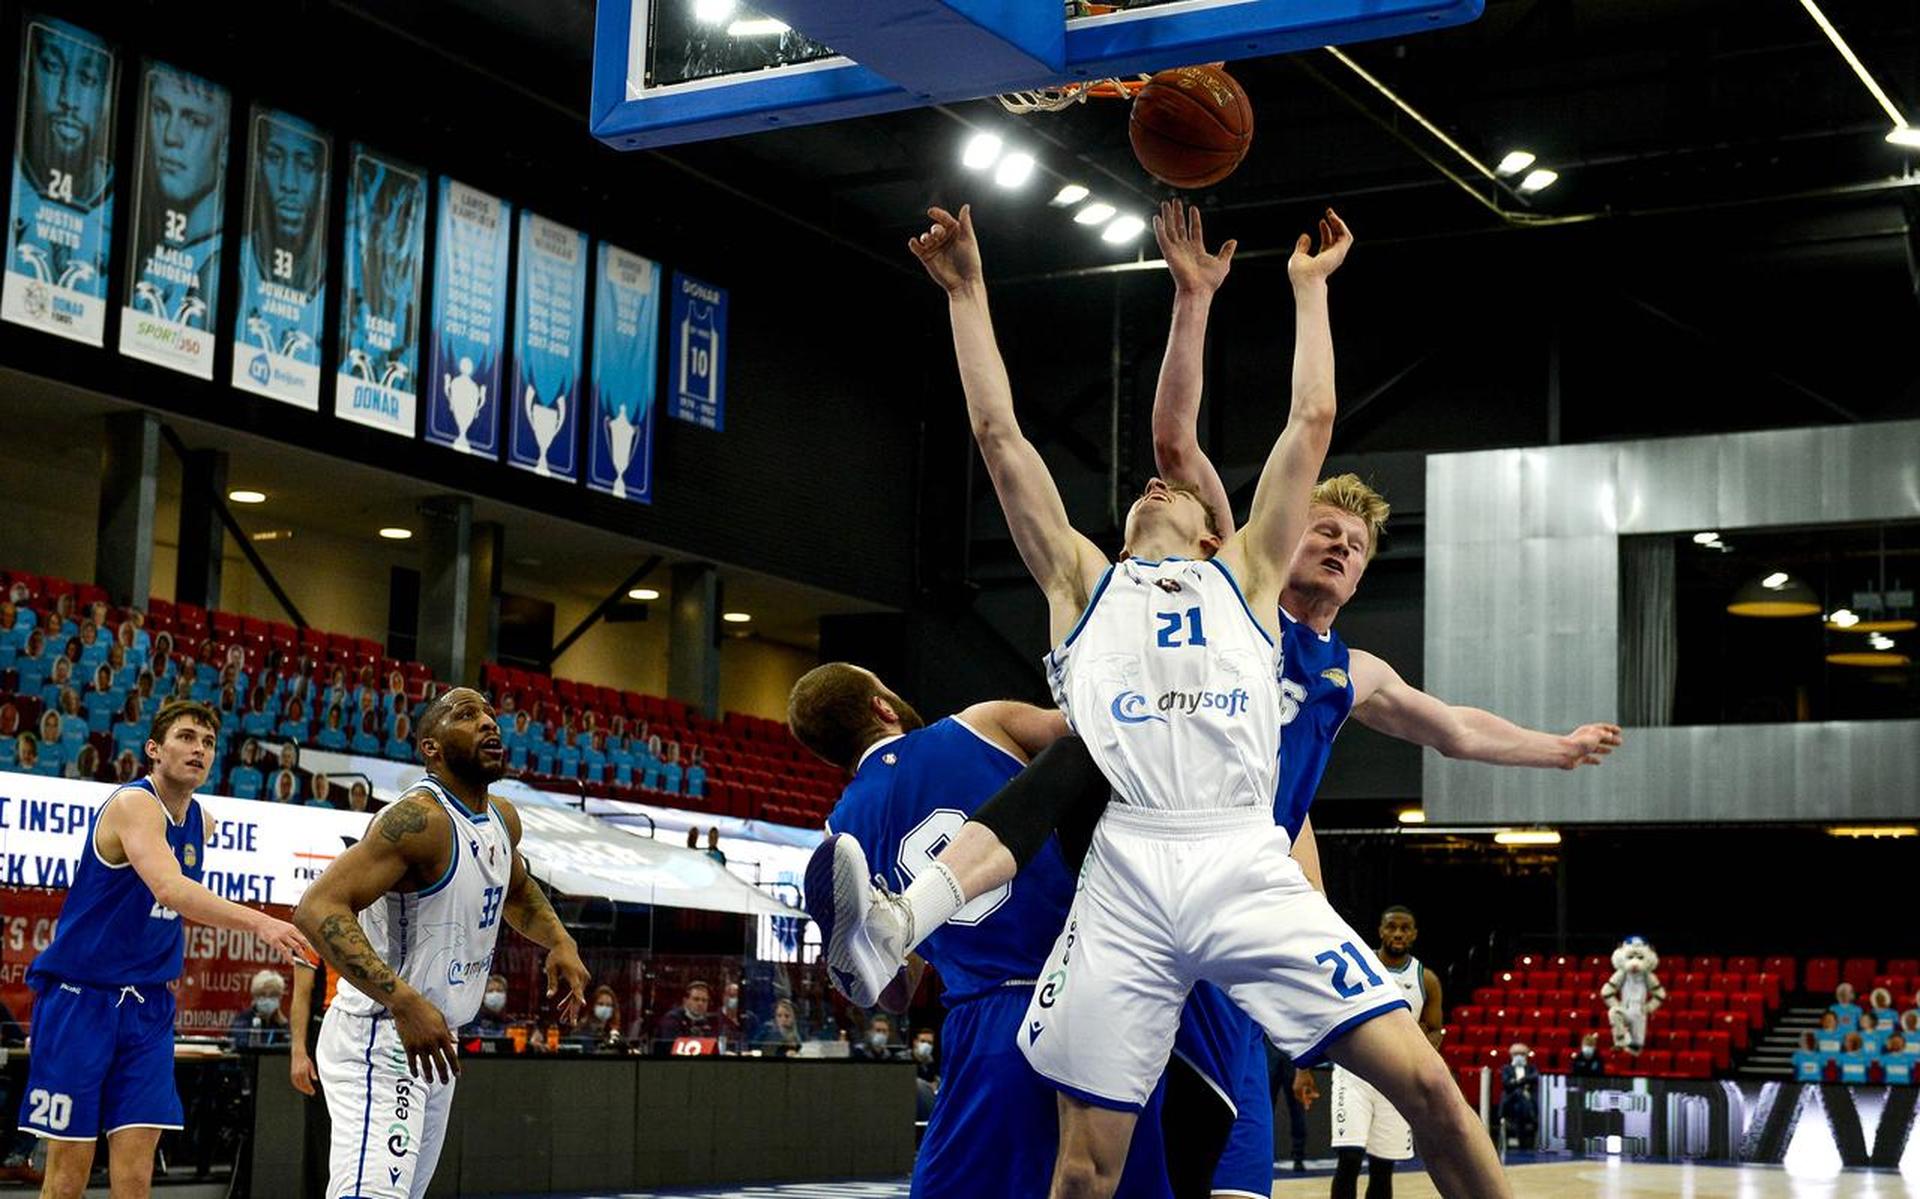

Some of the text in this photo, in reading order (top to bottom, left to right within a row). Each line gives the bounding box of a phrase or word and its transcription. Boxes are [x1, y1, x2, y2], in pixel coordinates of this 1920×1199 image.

[48, 168, 73, 203] 24
[36, 205, 84, 232] JUSTIN
[164, 209, 187, 242] 32
[36, 221, 81, 250] WATTS
[273, 248, 294, 279] 33
[683, 280, 720, 304] DONAR
[691, 346, 708, 378] 10
[353, 385, 399, 421] DONAR
[1157, 607, 1207, 648] 21
[1158, 688, 1249, 719] anysoft
[201, 869, 275, 903] OMST
[479, 886, 503, 929] 33
[1315, 941, 1384, 999] 21
[29, 1088, 73, 1131] 20
